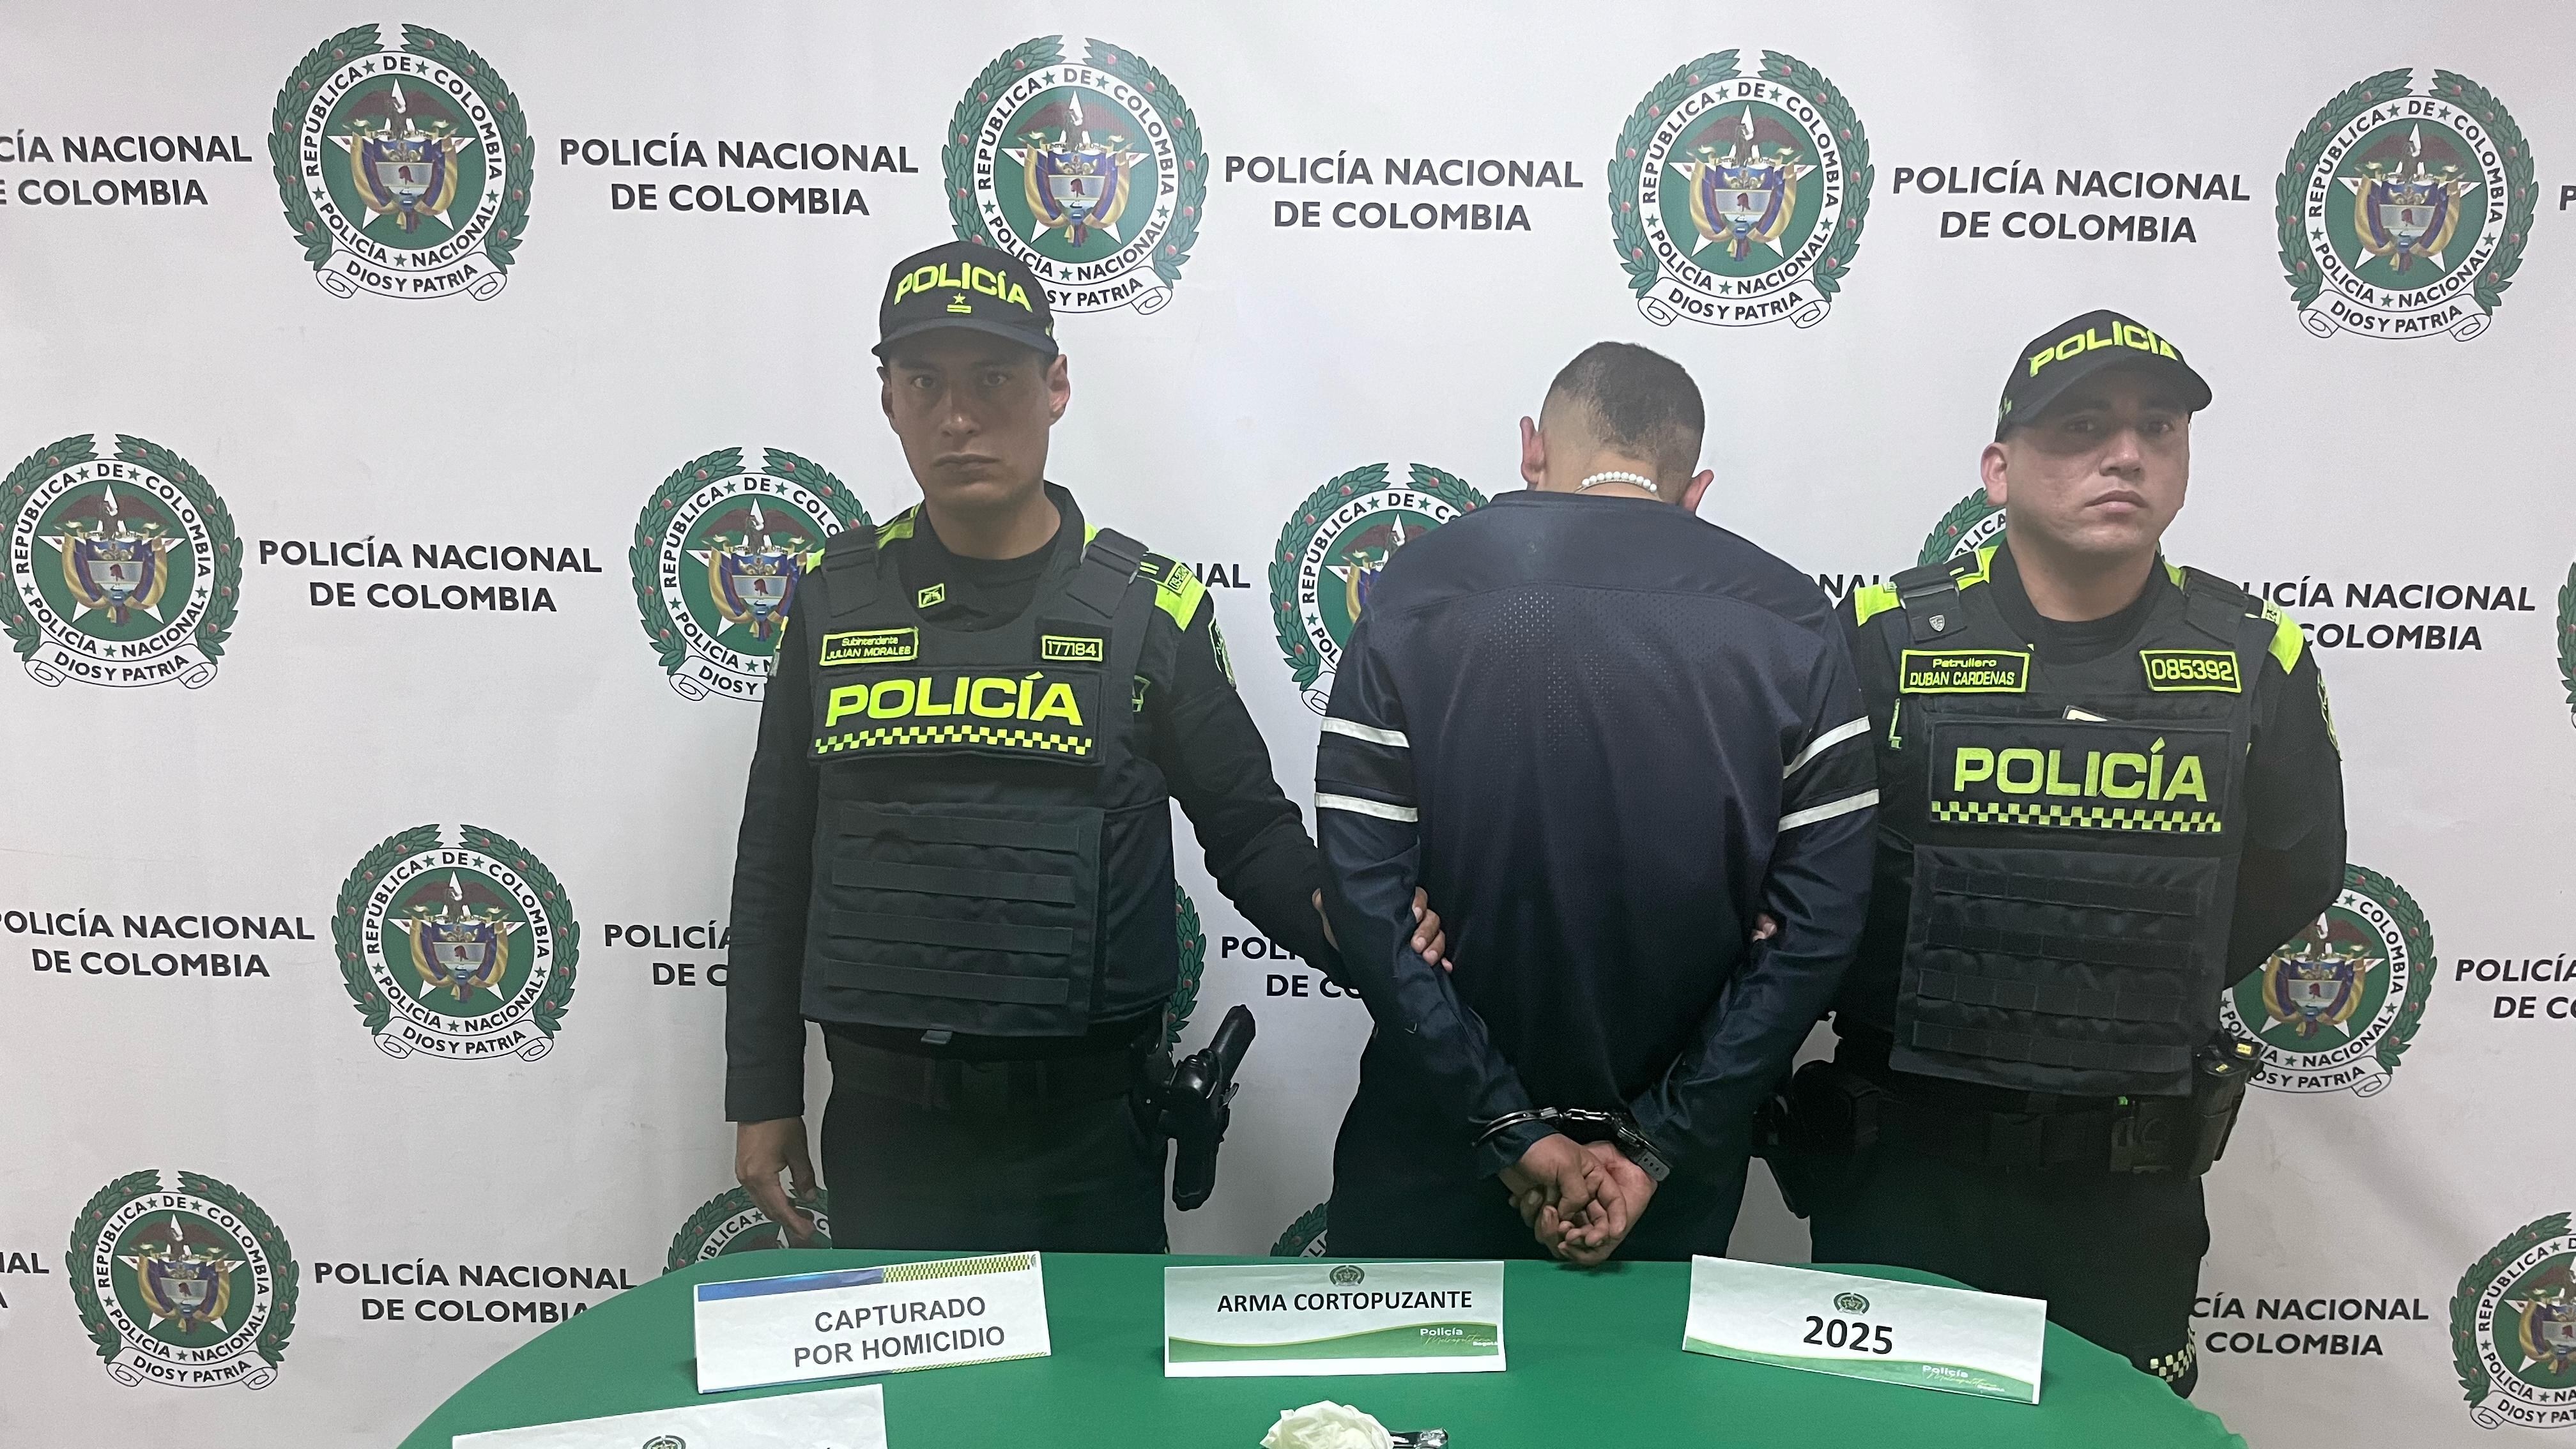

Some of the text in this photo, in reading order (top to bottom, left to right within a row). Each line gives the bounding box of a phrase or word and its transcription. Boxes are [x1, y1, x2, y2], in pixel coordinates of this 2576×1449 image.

[303, 56, 502, 180] REPÚBLICA DE COLOMBIA
[977, 68, 1174, 195] REPÚBLICA DE COLOMBIA
[62, 136, 252, 163] NACIONAL
[561, 132, 918, 172] POLICÍA NACIONAL
[1643, 82, 1840, 208] REPÚBLICA DE COLOMBIA
[2308, 100, 2504, 224] REPÚBLICA DE COLOMBIA
[1226, 150, 1583, 187] POLICÍA NACIONAL
[1894, 160, 2250, 201] POLICÍA NACIONAL
[19, 180, 208, 205] COLOMBIA
[611, 184, 870, 215] DE COLOMBIA
[1275, 201, 1531, 231] DE COLOMBIA
[1941, 211, 2196, 243] DE COLOMBIA
[319, 202, 496, 267] POLICÍA NACIONAL
[988, 215, 1166, 281] POLICÍA NACIONAL
[413, 264, 478, 293] PATRIA
[1650, 229, 1828, 295] POLICÍA NACIONAL
[2315, 242, 2491, 308] POLICÍA NACIONAL
[894, 262, 1032, 312] POLICÍA
[1077, 277, 1144, 307] PATRIA
[1735, 291, 1804, 321] PATRIA
[2395, 305, 2463, 333] PATRIA
[14, 463, 211, 578] REPÚBLICA DE COLOMBIA
[663, 477, 840, 588] REPÚBLICA DE COLO
[259, 535, 602, 572] POLICÍA NACIONAL
[1301, 502, 1367, 604] REPÚBLICA
[1388, 493, 1414, 508] DE
[310, 582, 556, 611] DE COLOMBIA
[2243, 576, 2535, 611] ICÍA NACIONAL
[28, 597, 205, 658] POLICÍA NACIONAL
[675, 611, 739, 670] POLICÍA
[826, 646, 911, 660] JULIAN MORALES
[1047, 640, 1096, 656] 177184
[1933, 657, 1997, 668] Patrullero
[122, 655, 190, 682] PATRIA
[1910, 671, 2015, 686] DUBAN CARDENAS
[2150, 658, 2235, 681] 085392
[825, 671, 1084, 726] POLICÍA
[1954, 737, 2207, 802] POLICÍA
[365, 852, 550, 958] REPÚBLICA DE COLOMBIA
[0, 908, 314, 940] OLICÍA NACIONAL
[32, 949, 270, 977] DE COLOMBIA
[2359, 901, 2405, 994] COLOMBIA
[653, 963, 695, 986] DE
[1267, 974, 1308, 997] DE
[378, 976, 544, 1032] POLICÍA NACIONAL
[2494, 997, 2536, 1018] DE
[465, 1030, 527, 1054] PATRIA
[2302, 1015, 2393, 1068] NACIONAL
[2297, 1066, 2366, 1089] PATRIA
[96, 1195, 270, 1295] REPÚBLICA DE COLOMBIA
[315, 1258, 637, 1289] POLICÍA NACIONAL
[2478, 1246, 2549, 1332] REPÚBLICA
[362, 1299, 404, 1320] DE
[815, 1296, 986, 1333] CAPTURADO
[1218, 1291, 1471, 1312] ARMA CORTOPUZANTE
[2256, 1299, 2428, 1320] NACIONAL
[109, 1308, 265, 1362] POLICÍA NACIONAL
[795, 1326, 1004, 1367] POR HOMICIDIO
[1420, 1327, 1463, 1336] Policía
[1804, 1316, 1892, 1354] 2025
[2205, 1332, 2382, 1355] COLOMBIA
[193, 1360, 252, 1383] PATRIA
[1922, 1364, 1968, 1378] Policía
[2483, 1352, 2534, 1400] POLICÍA
